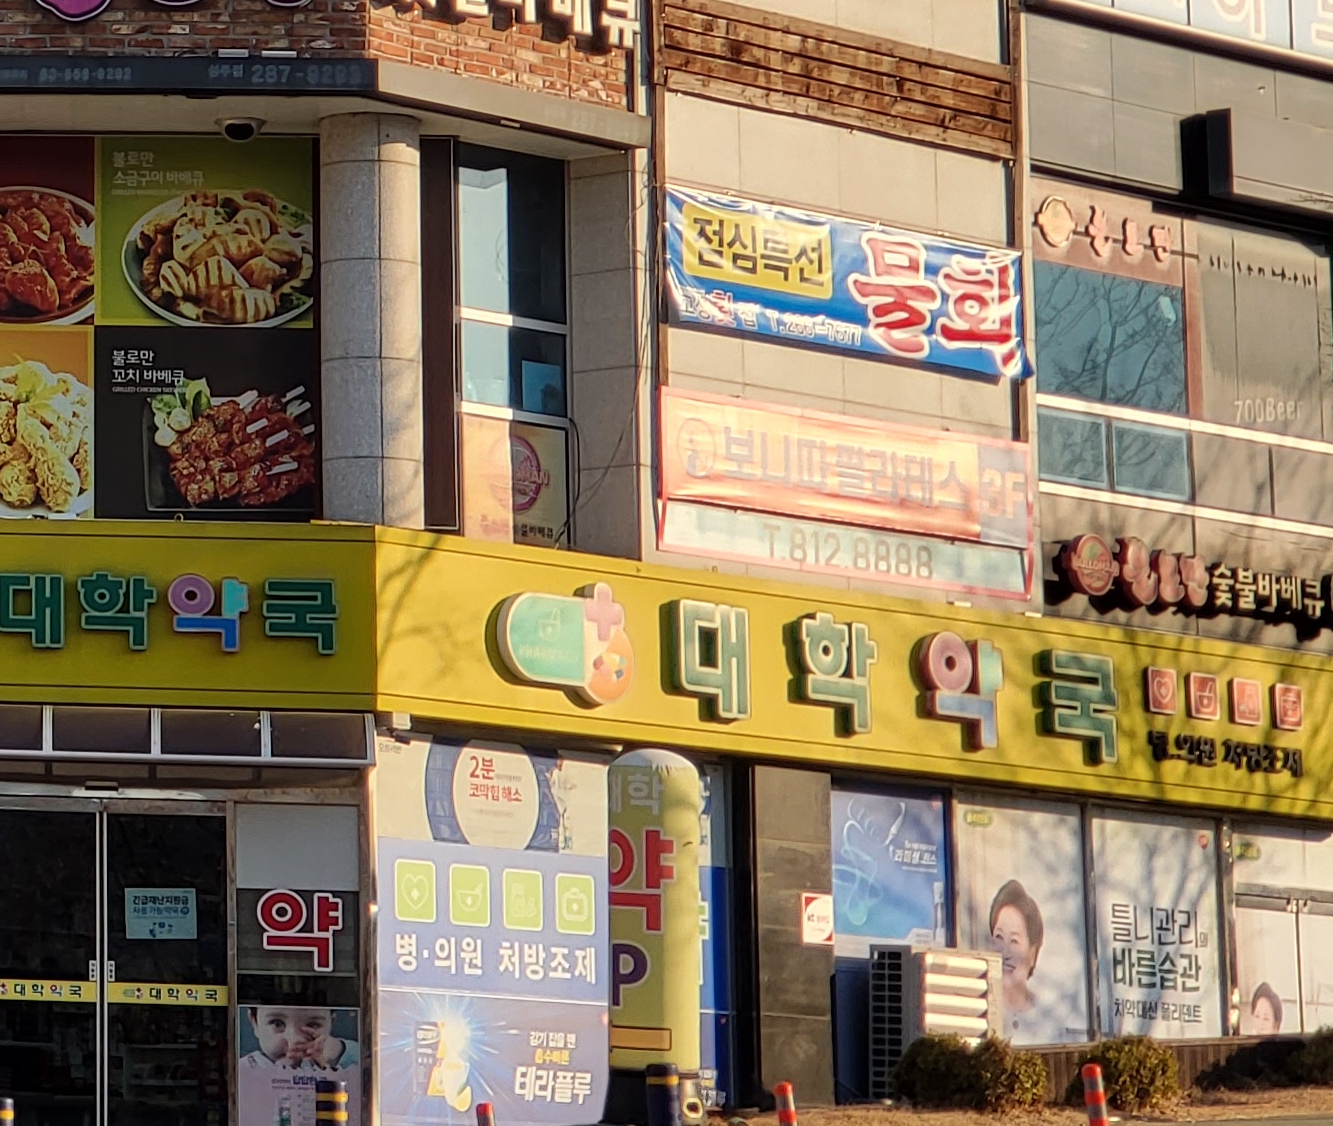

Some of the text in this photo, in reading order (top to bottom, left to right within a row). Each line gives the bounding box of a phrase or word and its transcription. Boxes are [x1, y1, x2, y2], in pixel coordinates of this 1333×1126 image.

[112, 150, 156, 168] 불로만
[113, 169, 166, 185] 소금구이
[846, 230, 1023, 380] 물회
[111, 349, 155, 366] 불로만
[111, 367, 186, 384] 꼬치 바베큐
[723, 426, 1026, 520] 보니따필라테스 3F
[762, 523, 935, 581] T.812.8888
[1211, 560, 1326, 618] 숯불바베큐
[673, 599, 1120, 766] 대학약국
[468, 755, 496, 781] 2분
[501, 785, 523, 803] 해소
[609, 826, 676, 933] 약
[256, 889, 343, 972] 약
[1111, 902, 1209, 951] 틀니관리의
[498, 941, 598, 985] 처방조제
[1112, 947, 1202, 993] 바른습관
[12, 982, 83, 999] 대학약국
[149, 986, 219, 1002] 대학약국
[1160, 1000, 1203, 1023] 폴리덴트
[514, 1065, 593, 1105] 테라플루
